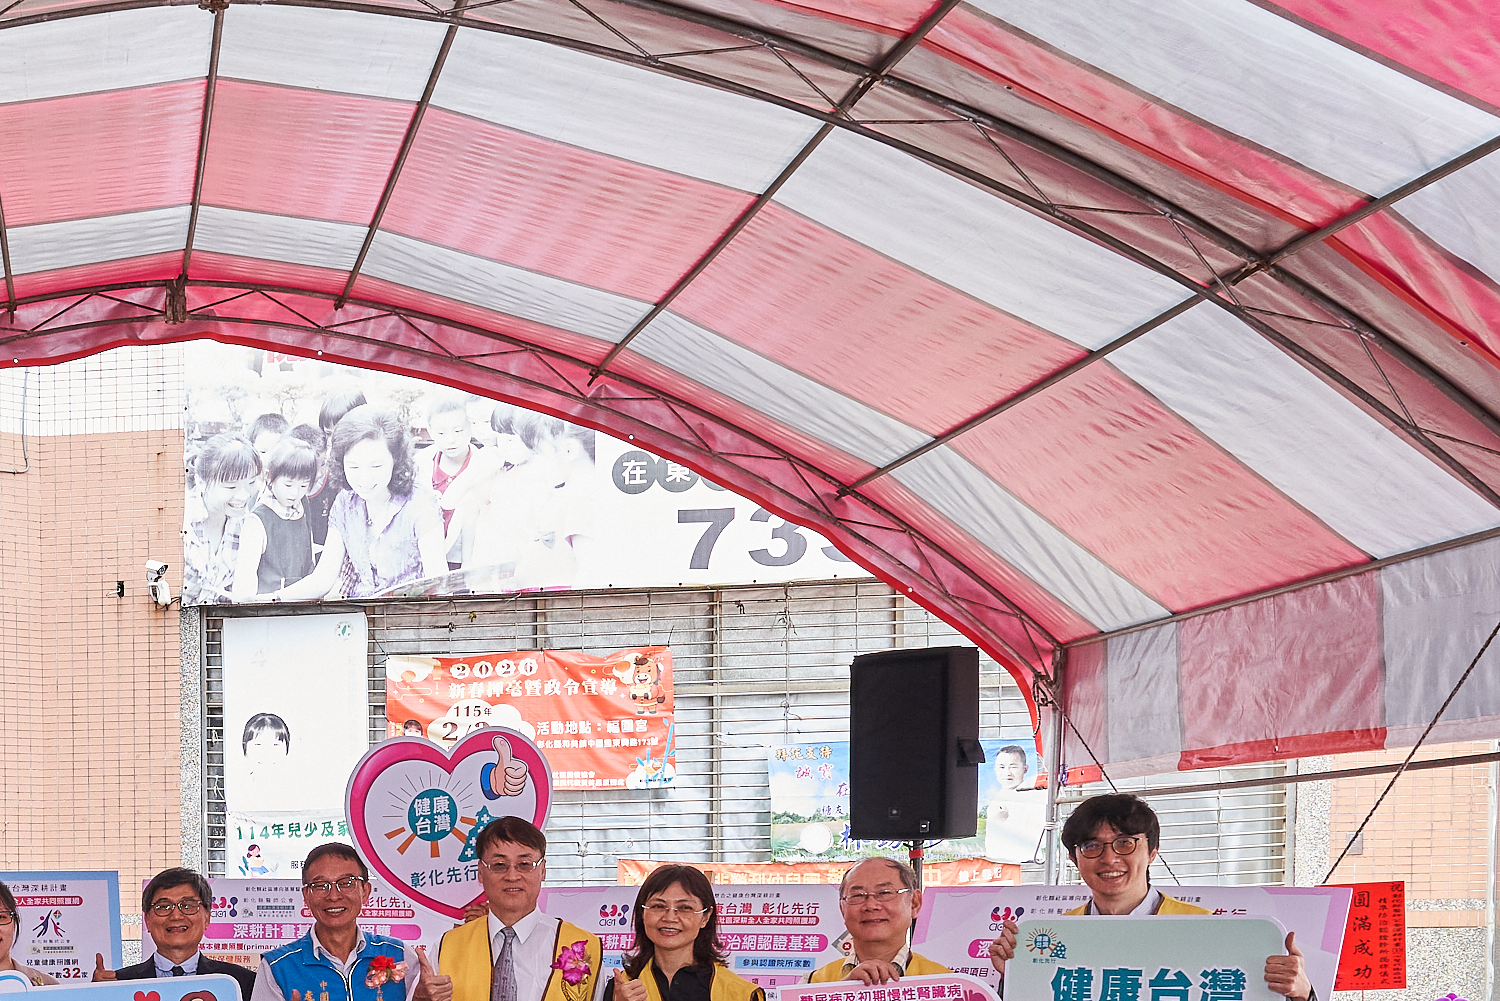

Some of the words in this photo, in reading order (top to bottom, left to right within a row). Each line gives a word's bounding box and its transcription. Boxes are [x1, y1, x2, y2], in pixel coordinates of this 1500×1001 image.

[678, 508, 852, 570] 73
[456, 661, 533, 678] 2026
[448, 678, 617, 700] 新春揮毫暨政令宣導
[453, 706, 492, 718] 115年
[413, 795, 450, 817] 健康
[415, 813, 451, 836] 台灣
[410, 864, 479, 889] 彰化先行
[762, 902, 820, 915] 彰化先行
[1353, 891, 1373, 979] 圓滿成功
